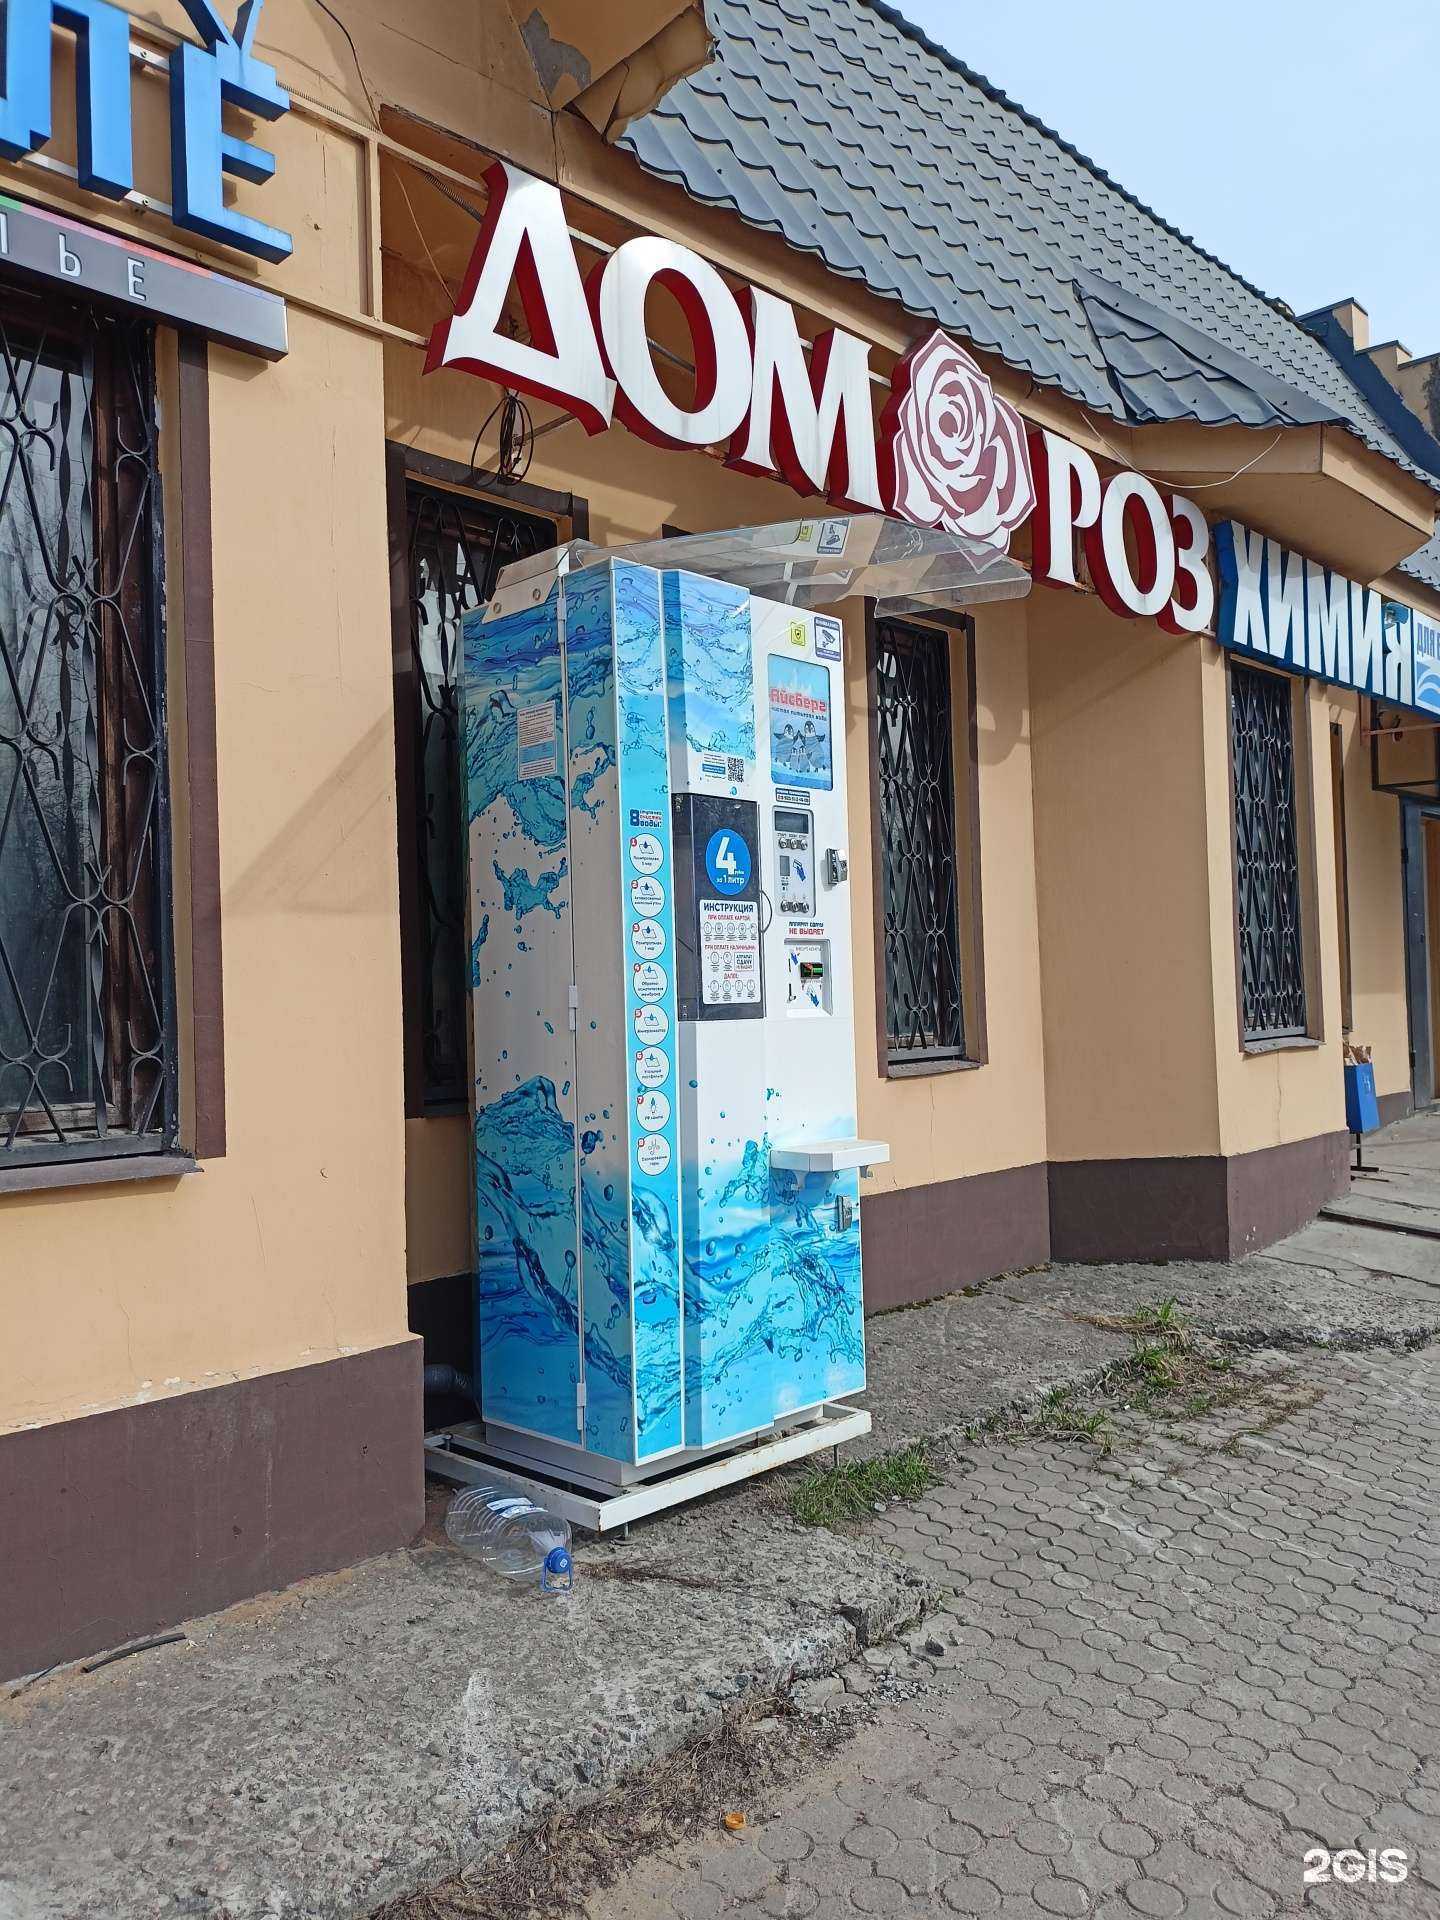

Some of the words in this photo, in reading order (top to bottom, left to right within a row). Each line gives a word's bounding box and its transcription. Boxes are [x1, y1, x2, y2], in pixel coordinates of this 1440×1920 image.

[428, 160, 884, 514] ДОМ
[1038, 430, 1215, 634] РОЗ
[1230, 520, 1413, 706] ХИМИЯ
[703, 902, 754, 914] ИНСТРУКЦИЯ
[715, 837, 737, 875] 4
